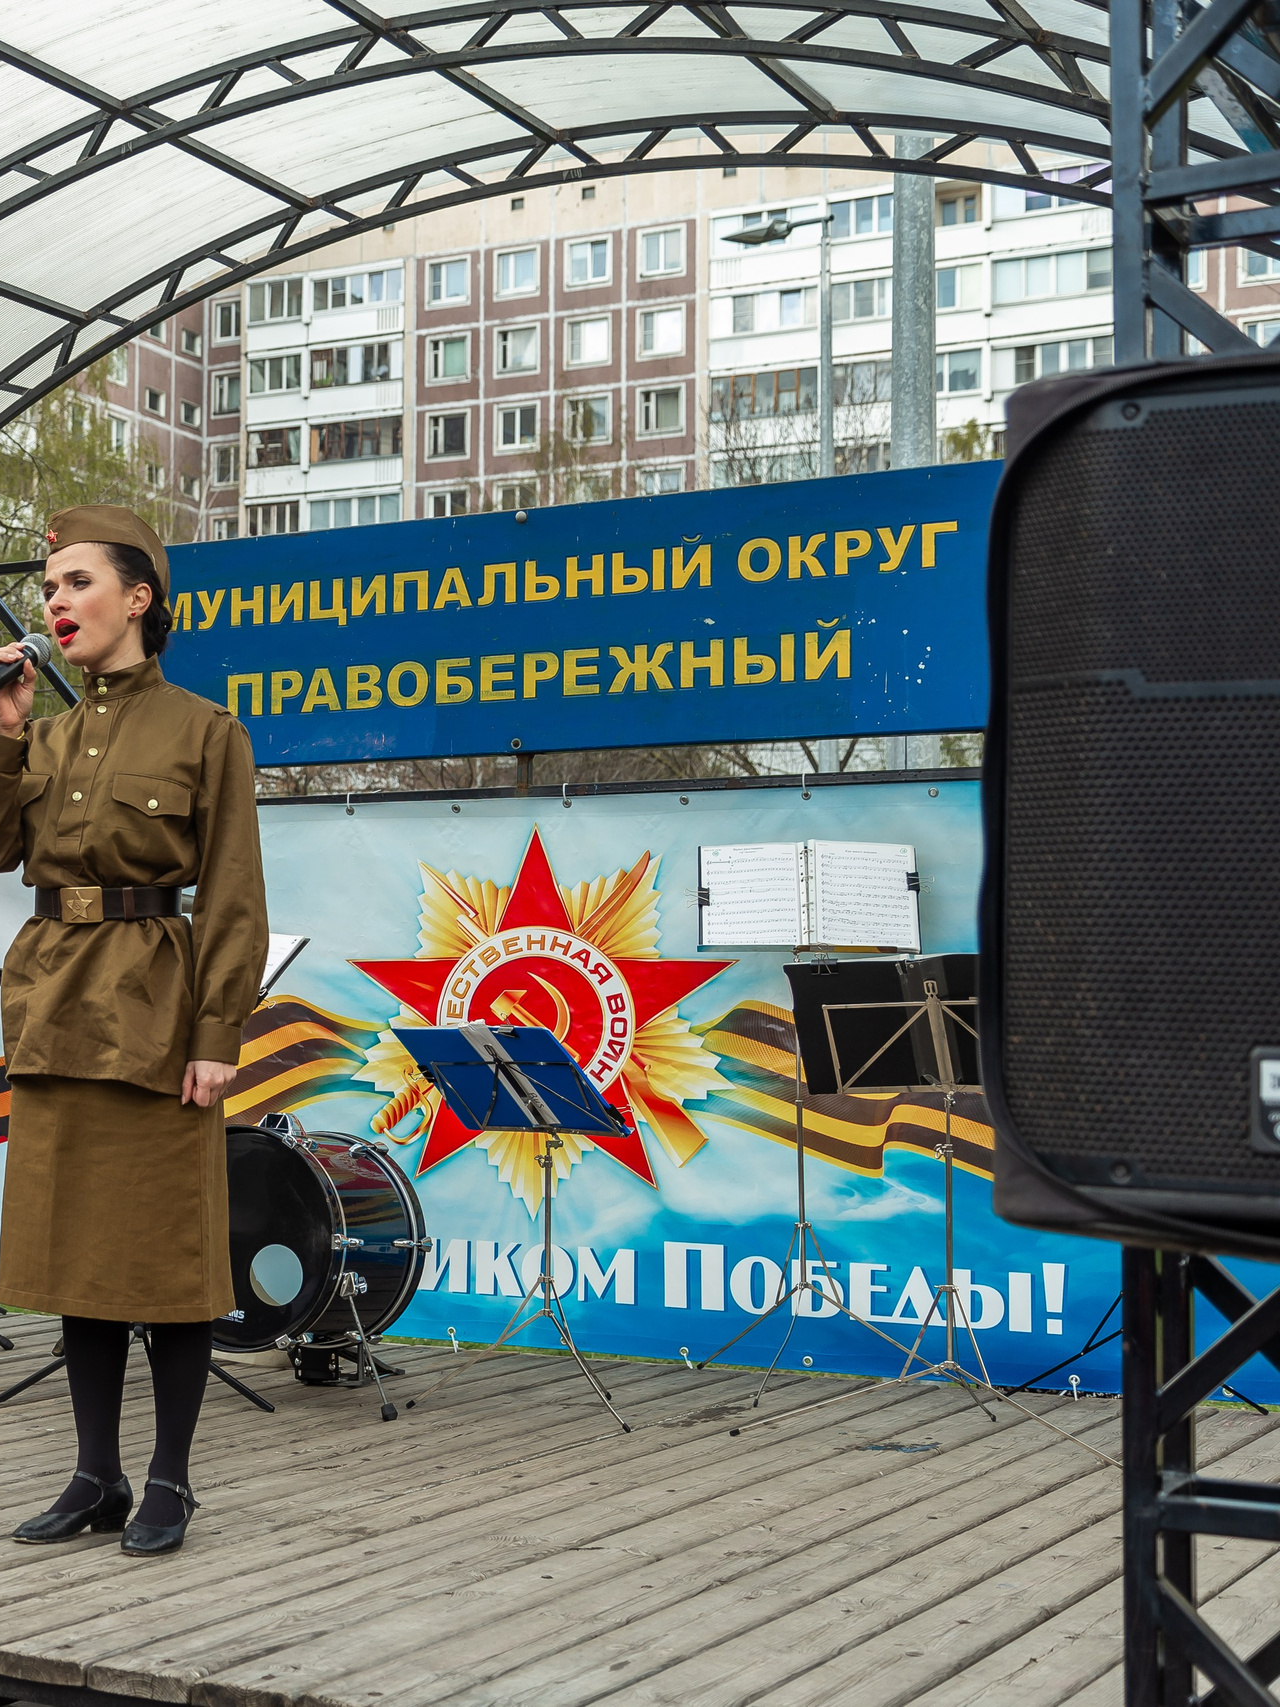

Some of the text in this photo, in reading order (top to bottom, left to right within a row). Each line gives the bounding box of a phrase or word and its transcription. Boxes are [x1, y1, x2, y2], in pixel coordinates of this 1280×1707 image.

[166, 521, 959, 634] МУНИЦИПАЛЬНЫЙ ОКРУГ
[226, 617, 852, 717] ПРАВОБЕРЕЖНЫЙ
[446, 934, 614, 1025] ЕСТВЕННАЯ
